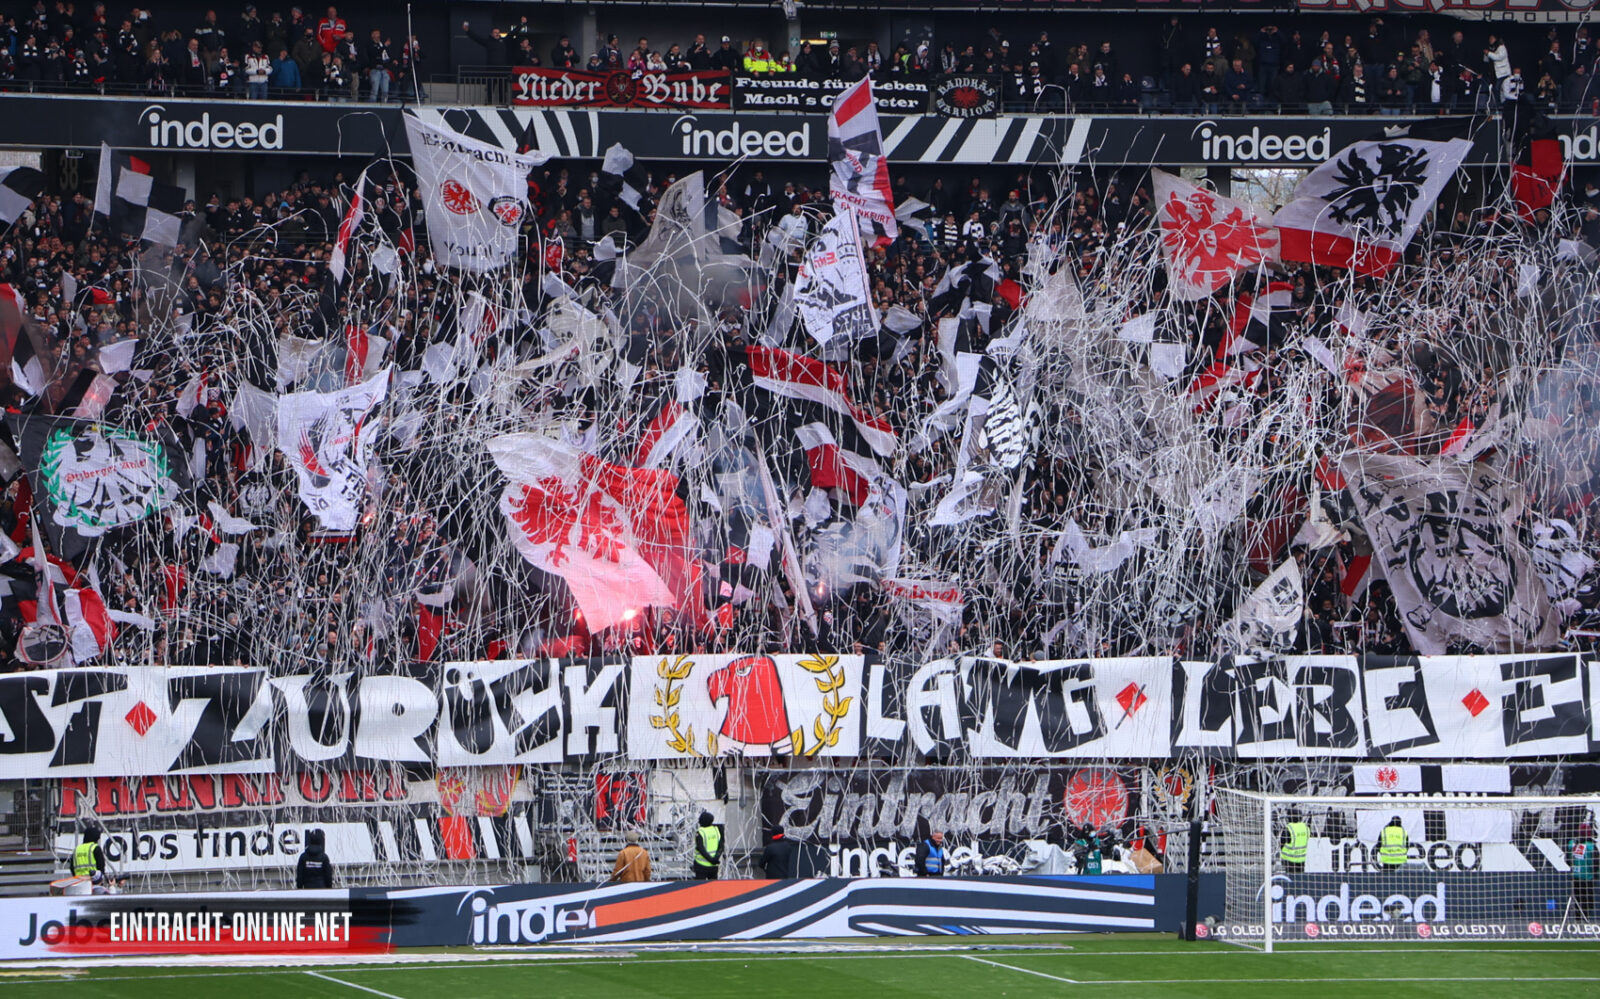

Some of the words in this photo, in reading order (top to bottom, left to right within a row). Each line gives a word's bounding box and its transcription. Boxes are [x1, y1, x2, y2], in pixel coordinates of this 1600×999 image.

[516, 72, 602, 101] Nieder
[643, 74, 722, 103] Bube
[736, 78, 815, 89] Freunde
[936, 99, 996, 118] WARRIORS
[138, 105, 284, 150] indeed
[671, 115, 810, 157] indeed
[1191, 121, 1331, 161] indeed
[168, 659, 626, 772] ZURÜCK
[1175, 660, 1430, 749] LEBE
[779, 773, 1053, 840] Eintracht
[104, 831, 178, 862] obs
[1270, 878, 1447, 922] indeed
[1321, 925, 1338, 935] LG
[1343, 924, 1376, 935] OLED
[1378, 924, 1395, 935] TV
[1433, 925, 1450, 935] LG
[1454, 924, 1488, 935] OLED
[1490, 924, 1506, 935] TV
